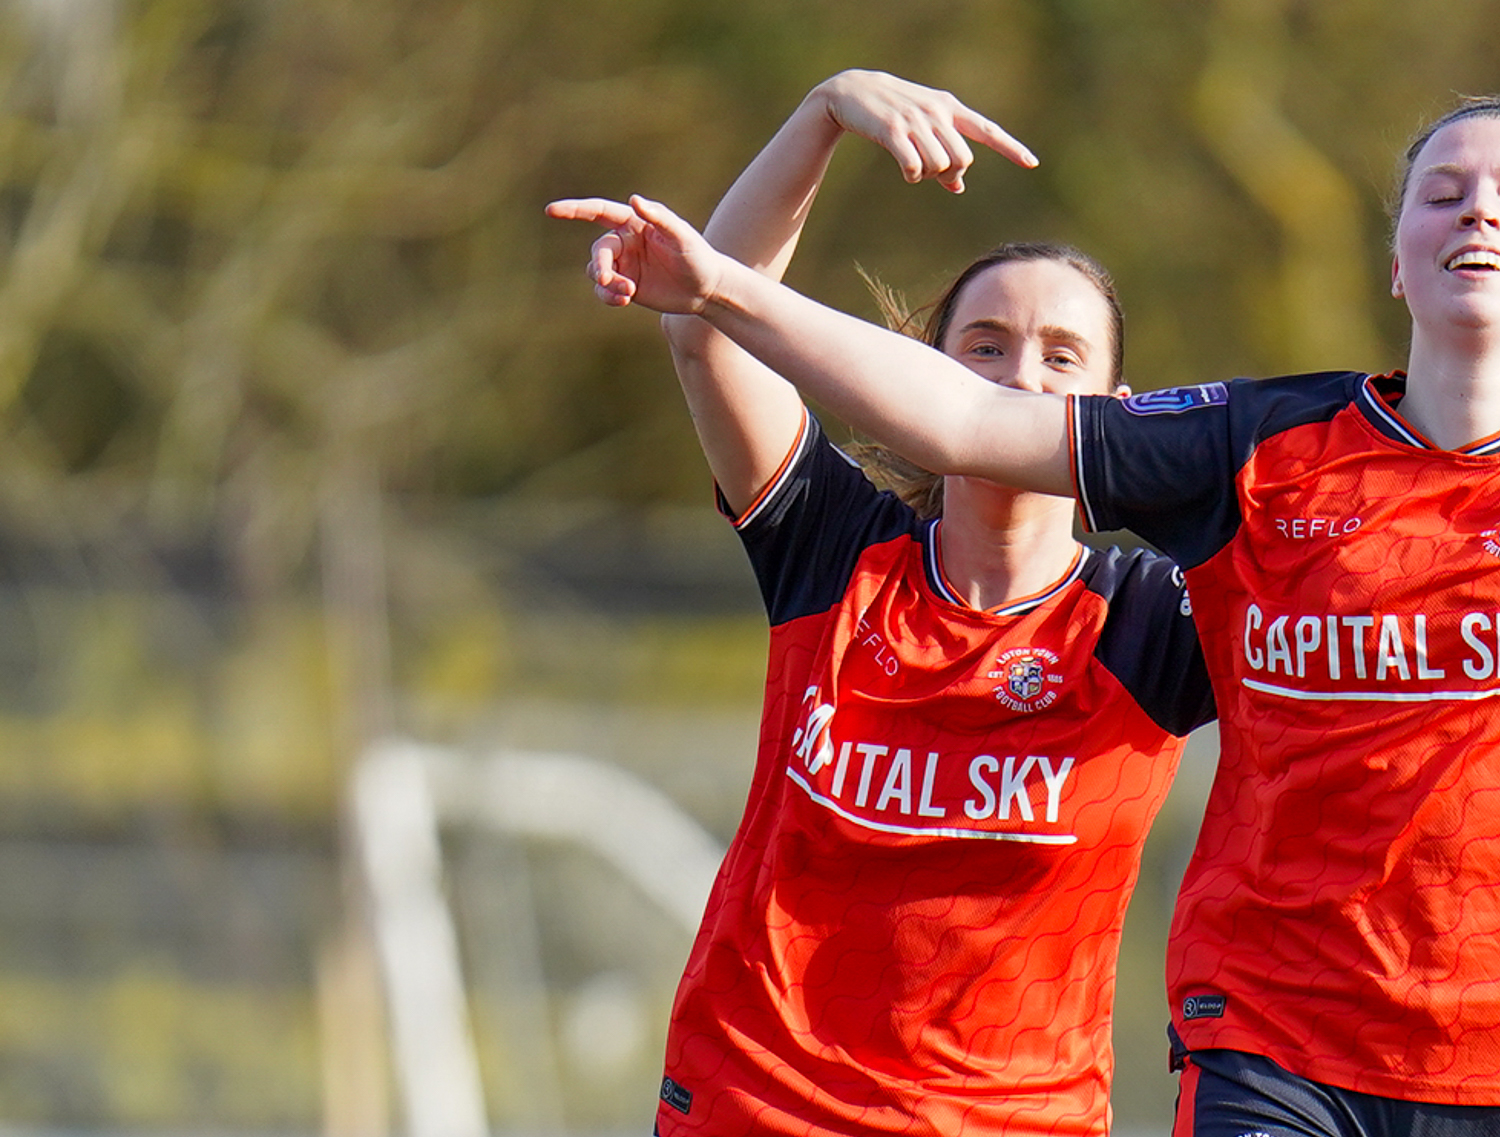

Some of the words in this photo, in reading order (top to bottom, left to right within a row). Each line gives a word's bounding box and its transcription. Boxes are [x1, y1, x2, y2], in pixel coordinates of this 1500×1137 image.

[1274, 517, 1362, 539] REFLO
[1243, 603, 1446, 681] CAPITAL
[963, 755, 1075, 824] SKY
